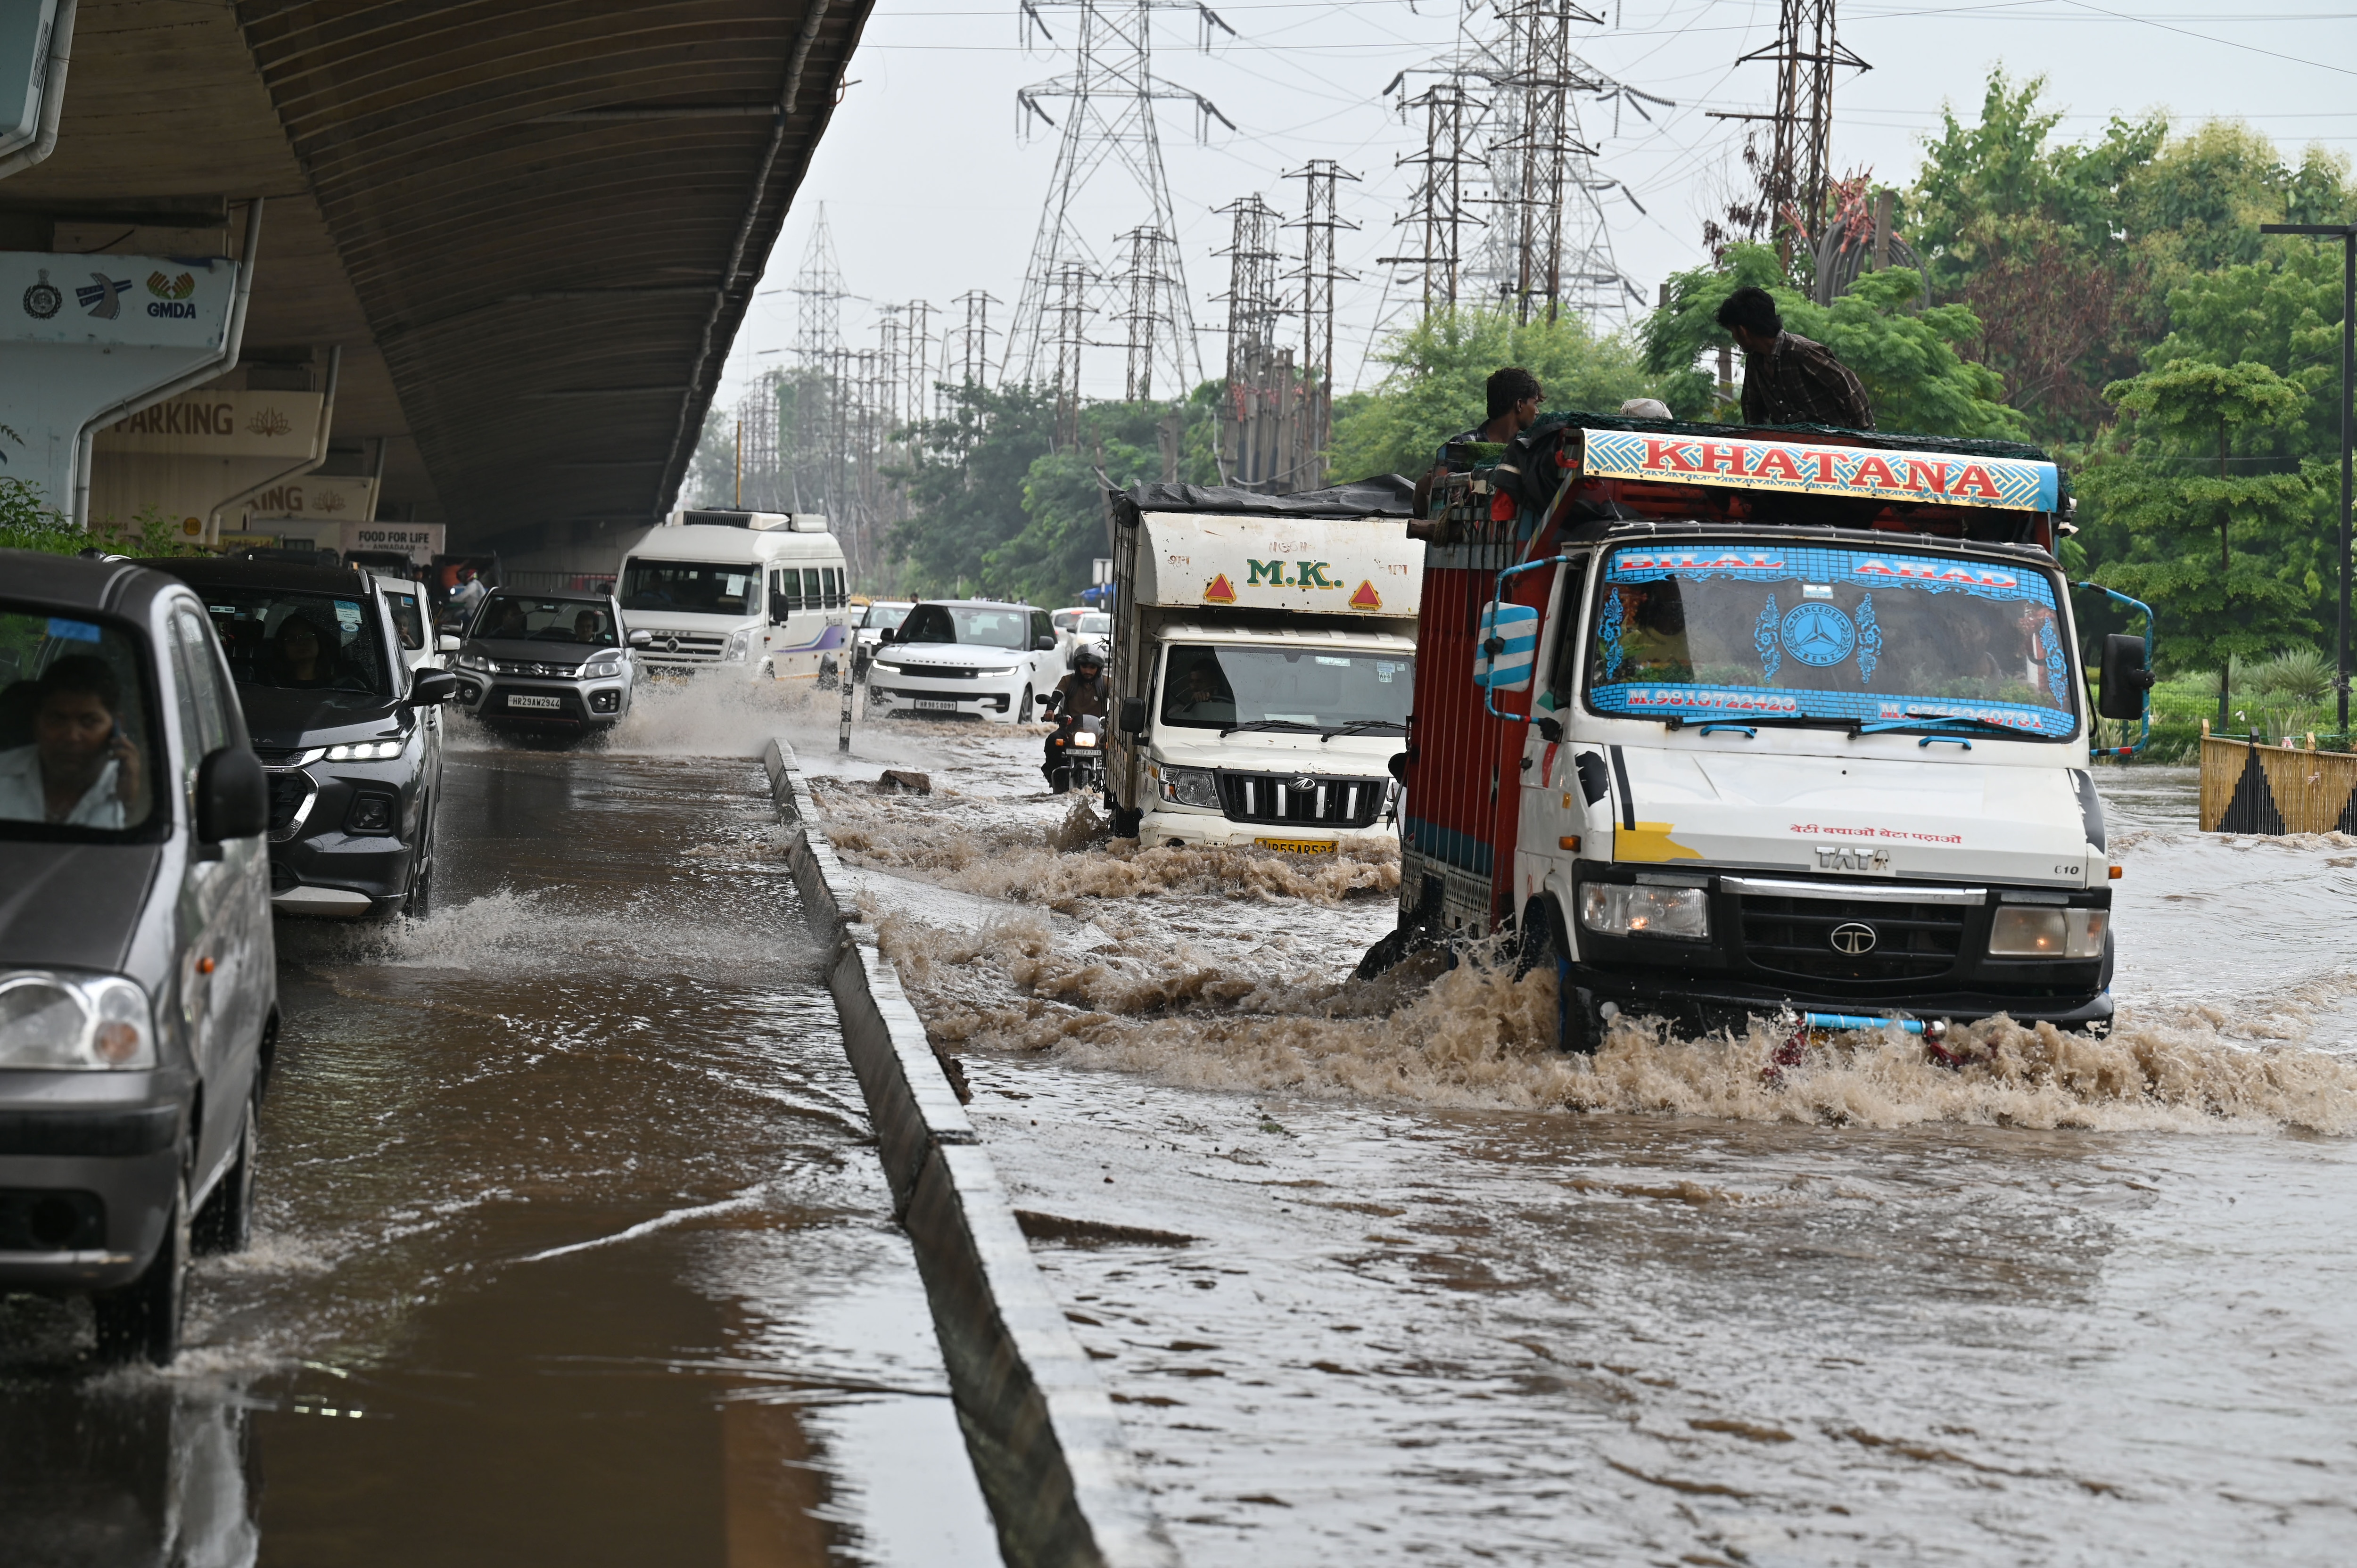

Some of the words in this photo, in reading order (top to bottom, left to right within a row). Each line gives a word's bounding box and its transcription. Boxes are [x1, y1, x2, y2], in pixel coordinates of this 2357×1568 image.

[147, 303, 196, 319] GMDA
[1640, 438, 2002, 498] KHATANA
[359, 531, 386, 542] FOOD
[388, 532, 407, 542] FOR
[410, 533, 429, 543] LIFE
[1246, 559, 1344, 590] M.K.
[1617, 553, 1785, 571] BILAL
[1854, 559, 2017, 588] AHAD
[1792, 607, 1842, 622] MERCEDES
[1803, 653, 1837, 662] BENZ
[513, 697, 560, 707] HR29AW2944
[1627, 690, 1797, 712] M.9813722423
[1790, 824, 1819, 833] बेटी
[1879, 828, 1908, 838] बेटा
[1816, 846, 1891, 870] TATA
